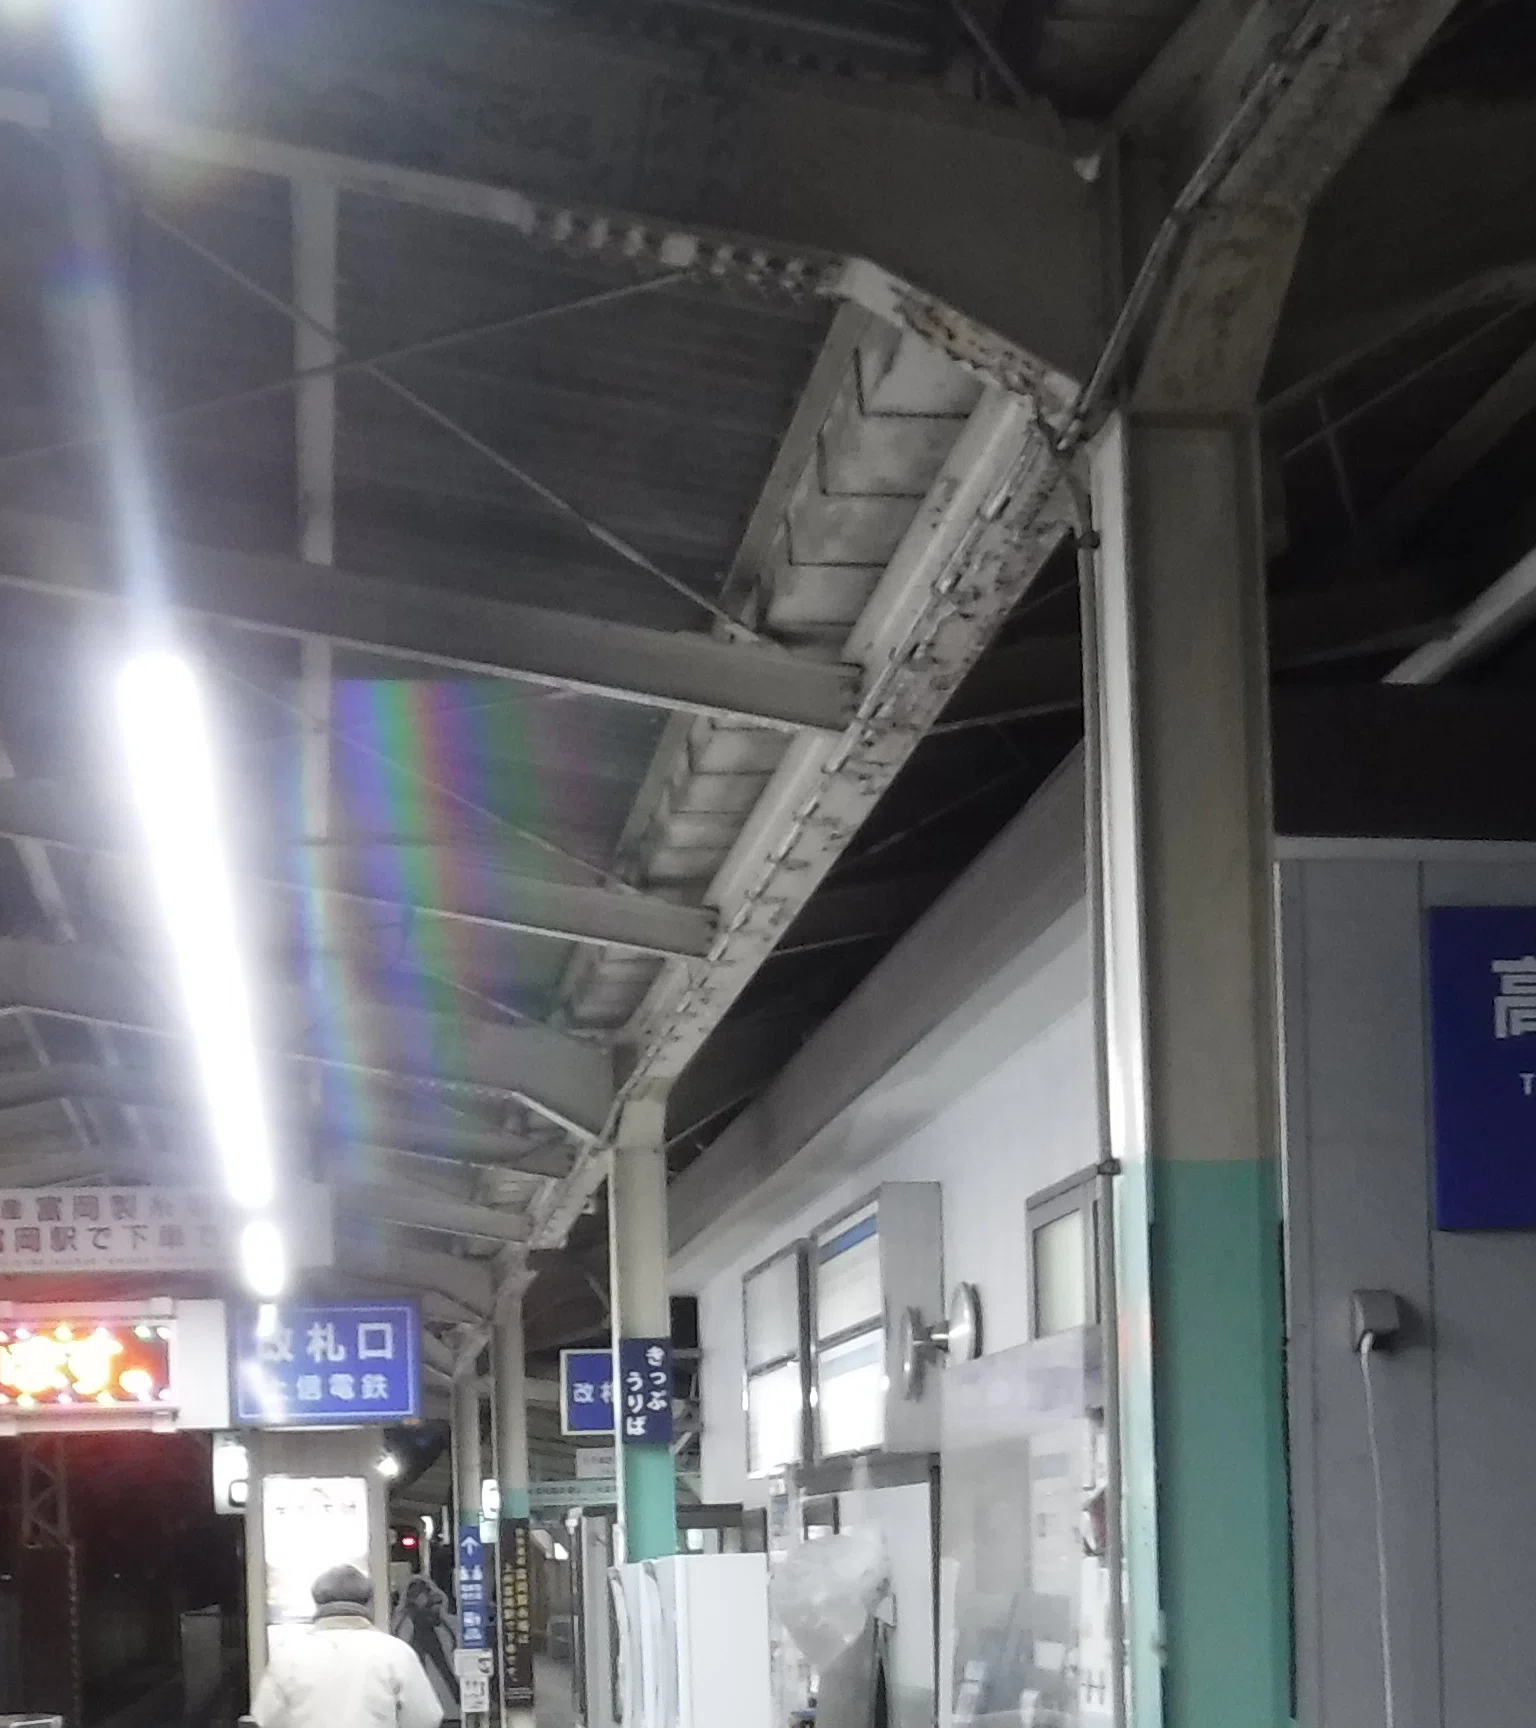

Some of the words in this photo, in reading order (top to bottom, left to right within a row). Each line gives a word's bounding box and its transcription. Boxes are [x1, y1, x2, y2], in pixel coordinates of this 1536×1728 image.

[258, 1321, 394, 1363] 改札口
[626, 1371, 648, 1436] うりば
